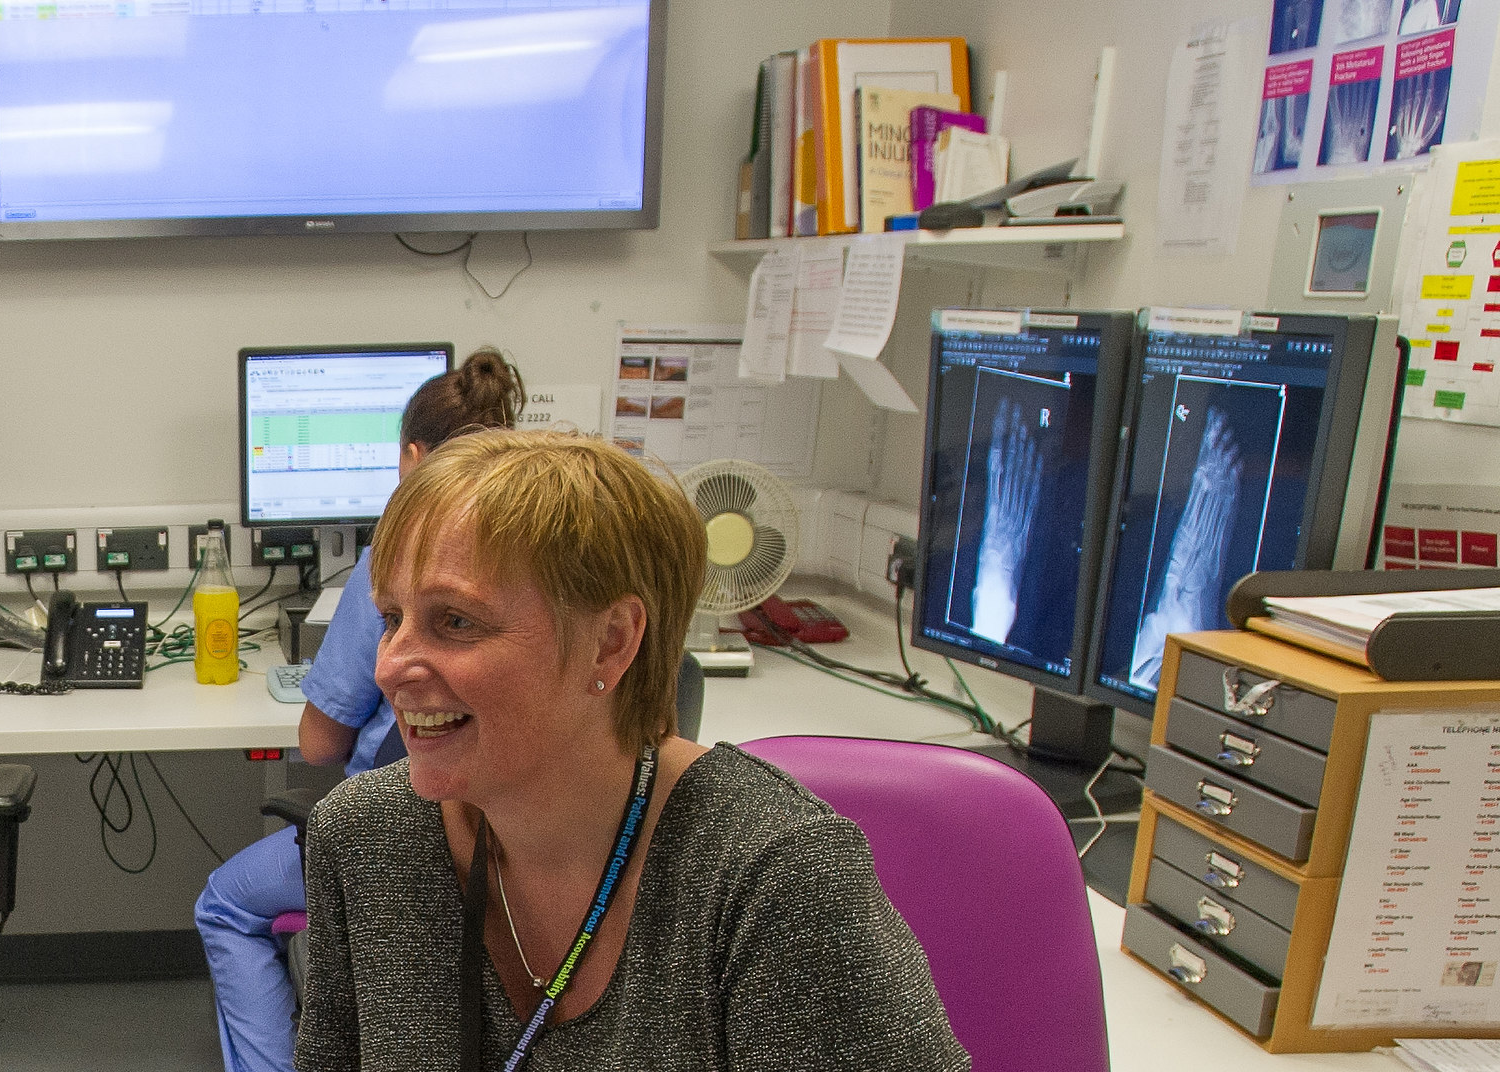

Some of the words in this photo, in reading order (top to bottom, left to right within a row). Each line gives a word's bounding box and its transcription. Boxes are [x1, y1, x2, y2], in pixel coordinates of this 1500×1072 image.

[1442, 726, 1490, 734] TELEPHONE
[637, 759, 655, 796] Values:
[626, 796, 647, 835] Patient
[617, 834, 636, 860] and
[597, 857, 626, 906] Customer
[584, 902, 606, 934] Focus
[545, 931, 592, 1000] Accountability
[514, 998, 556, 1057] Continuous
